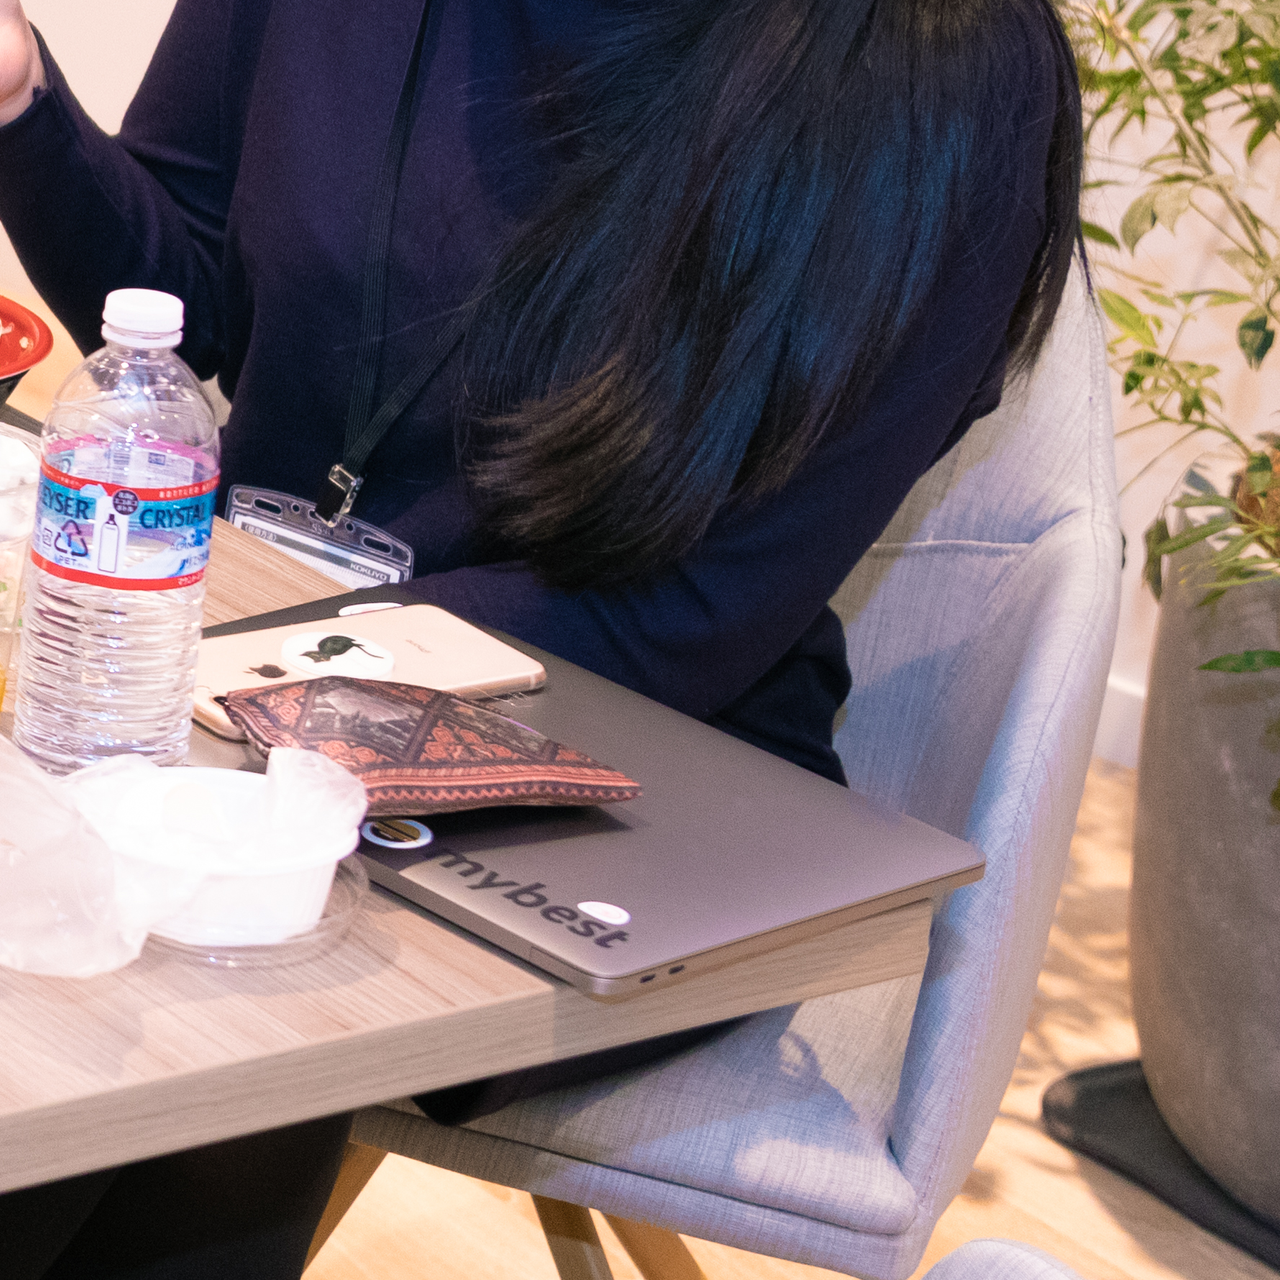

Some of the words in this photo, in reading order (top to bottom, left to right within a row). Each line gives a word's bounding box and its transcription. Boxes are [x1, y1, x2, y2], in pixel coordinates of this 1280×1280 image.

[42, 485, 90, 520] EYSER
[139, 503, 206, 530] CRYSTAL
[350, 562, 389, 581] KOKUYO
[438, 847, 630, 949] mybest
